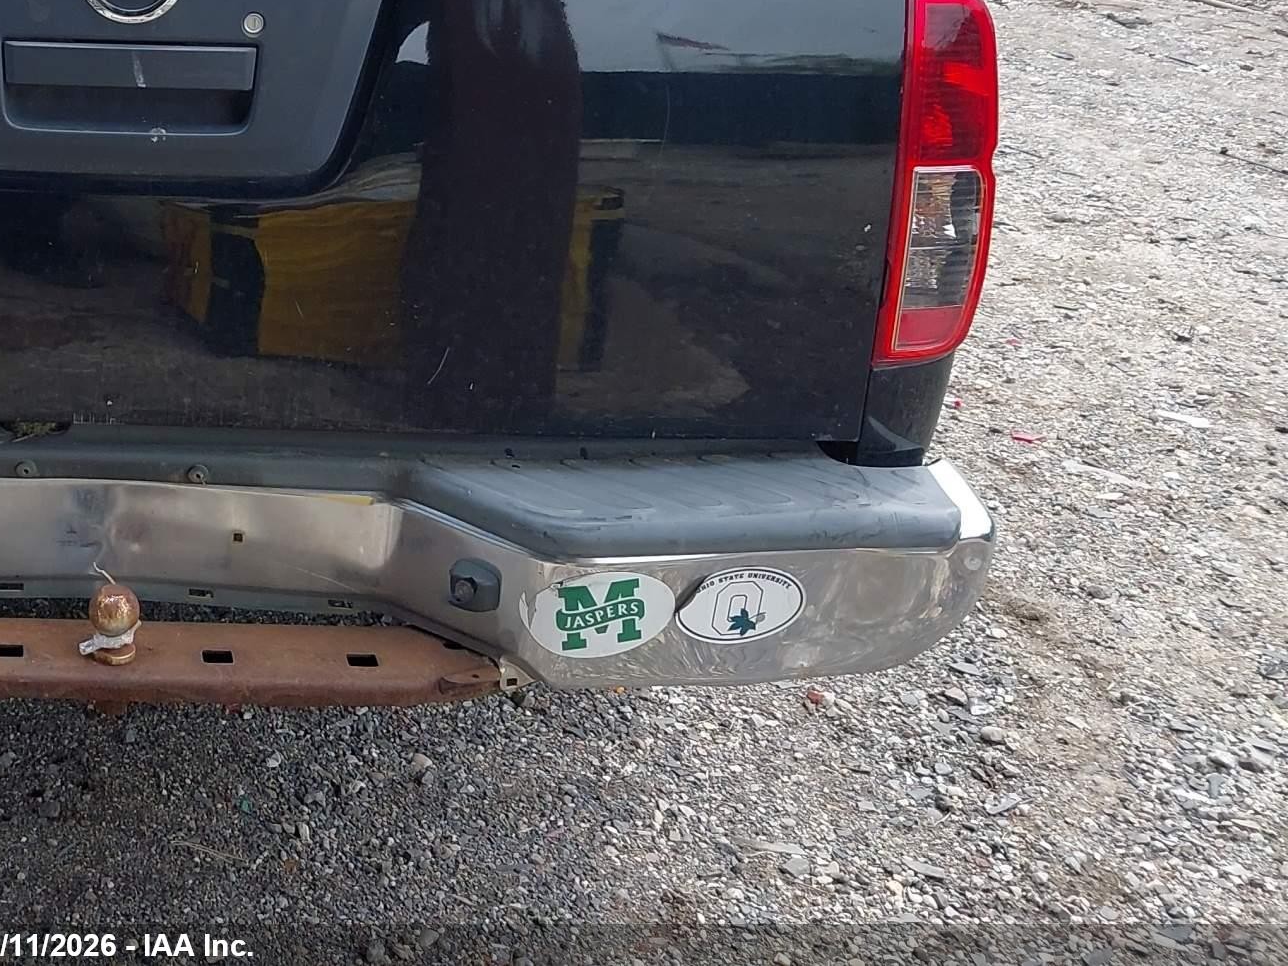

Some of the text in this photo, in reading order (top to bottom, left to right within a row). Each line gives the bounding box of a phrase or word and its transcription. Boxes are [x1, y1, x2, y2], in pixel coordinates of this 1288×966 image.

[695, 572, 792, 594] OHIO STATE UNIVERSITY
[564, 601, 640, 629] JASPERS
